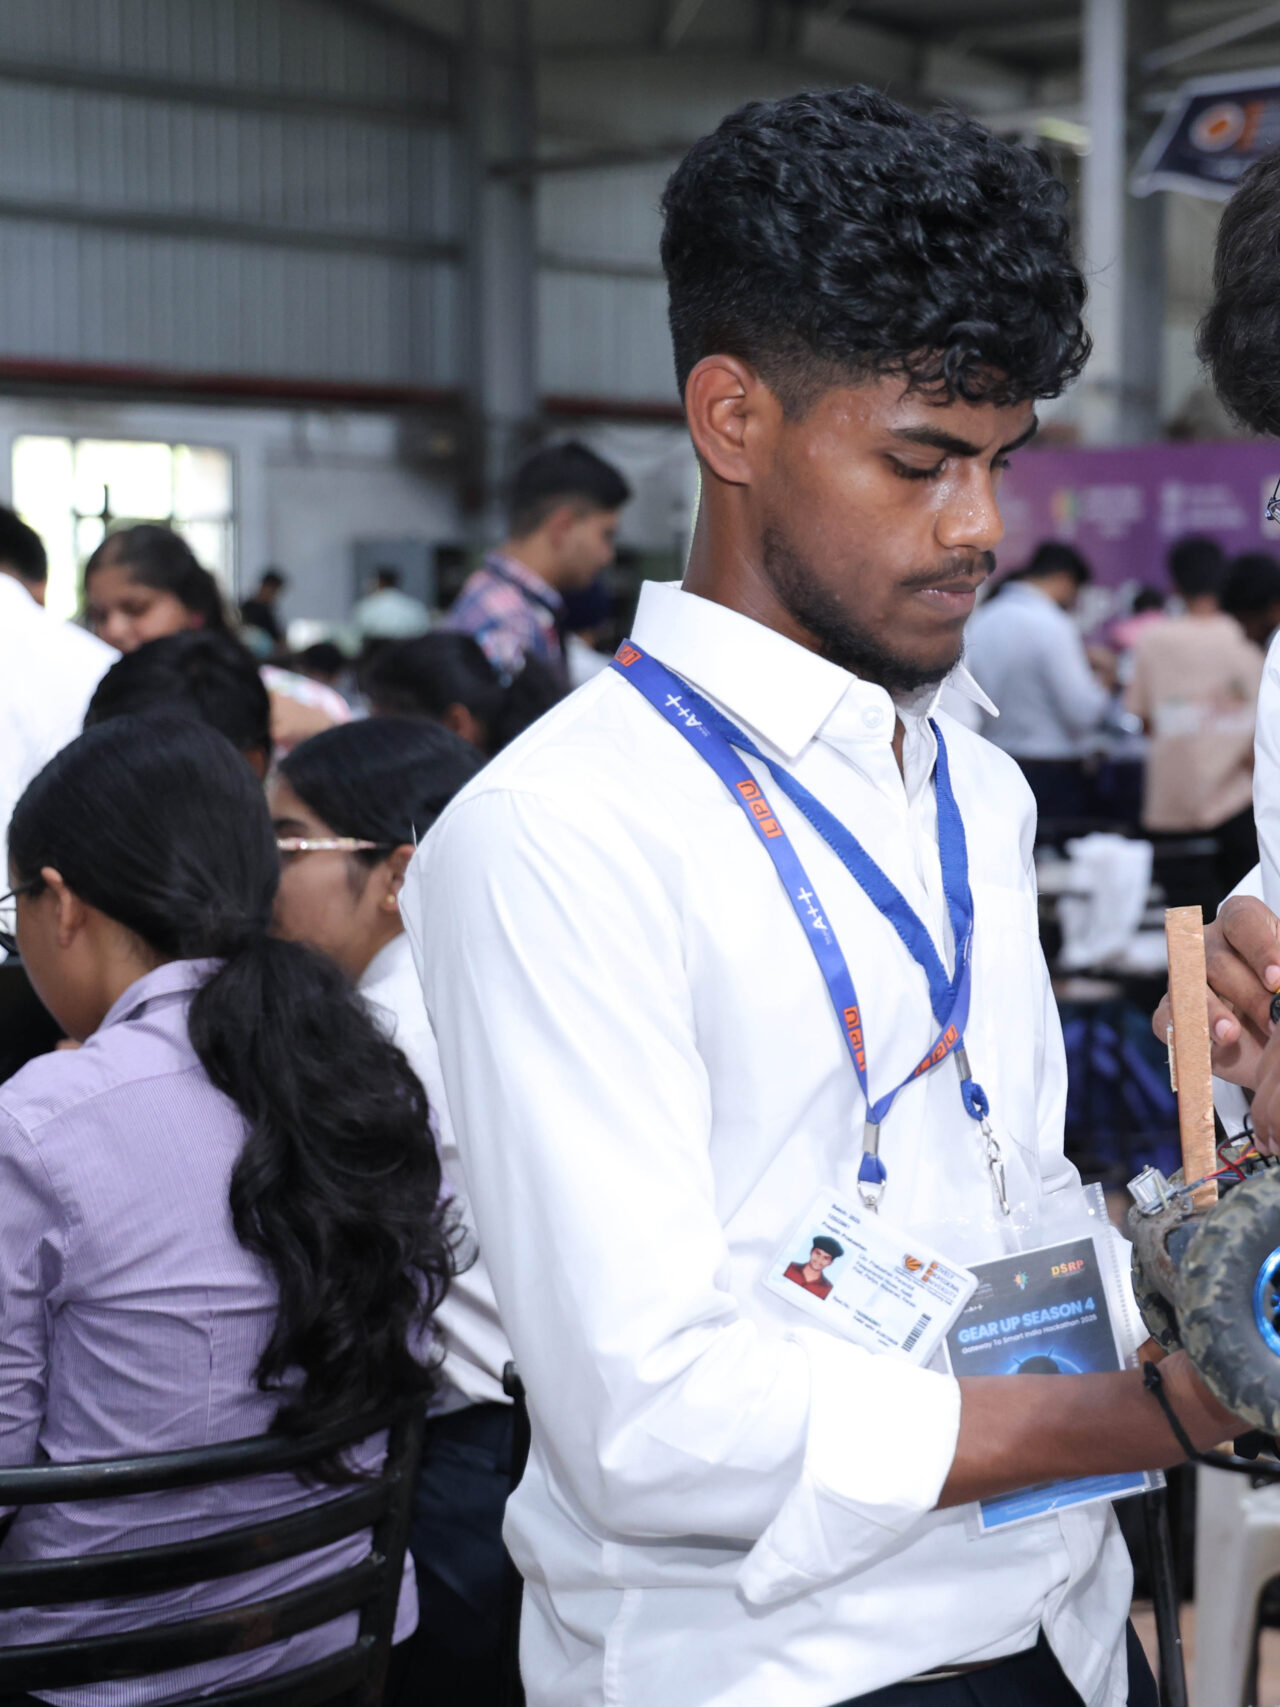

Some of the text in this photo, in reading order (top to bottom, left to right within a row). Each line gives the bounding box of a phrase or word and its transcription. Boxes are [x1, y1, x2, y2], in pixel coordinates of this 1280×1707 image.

[665, 694, 702, 727] A++
[738, 780, 783, 838] LPU
[798, 887, 828, 930] A++
[1051, 1260, 1084, 1277] DSRP
[958, 1296, 1096, 1343] GEAR UP SEASON 4
[961, 1342, 993, 1354] Gateway
